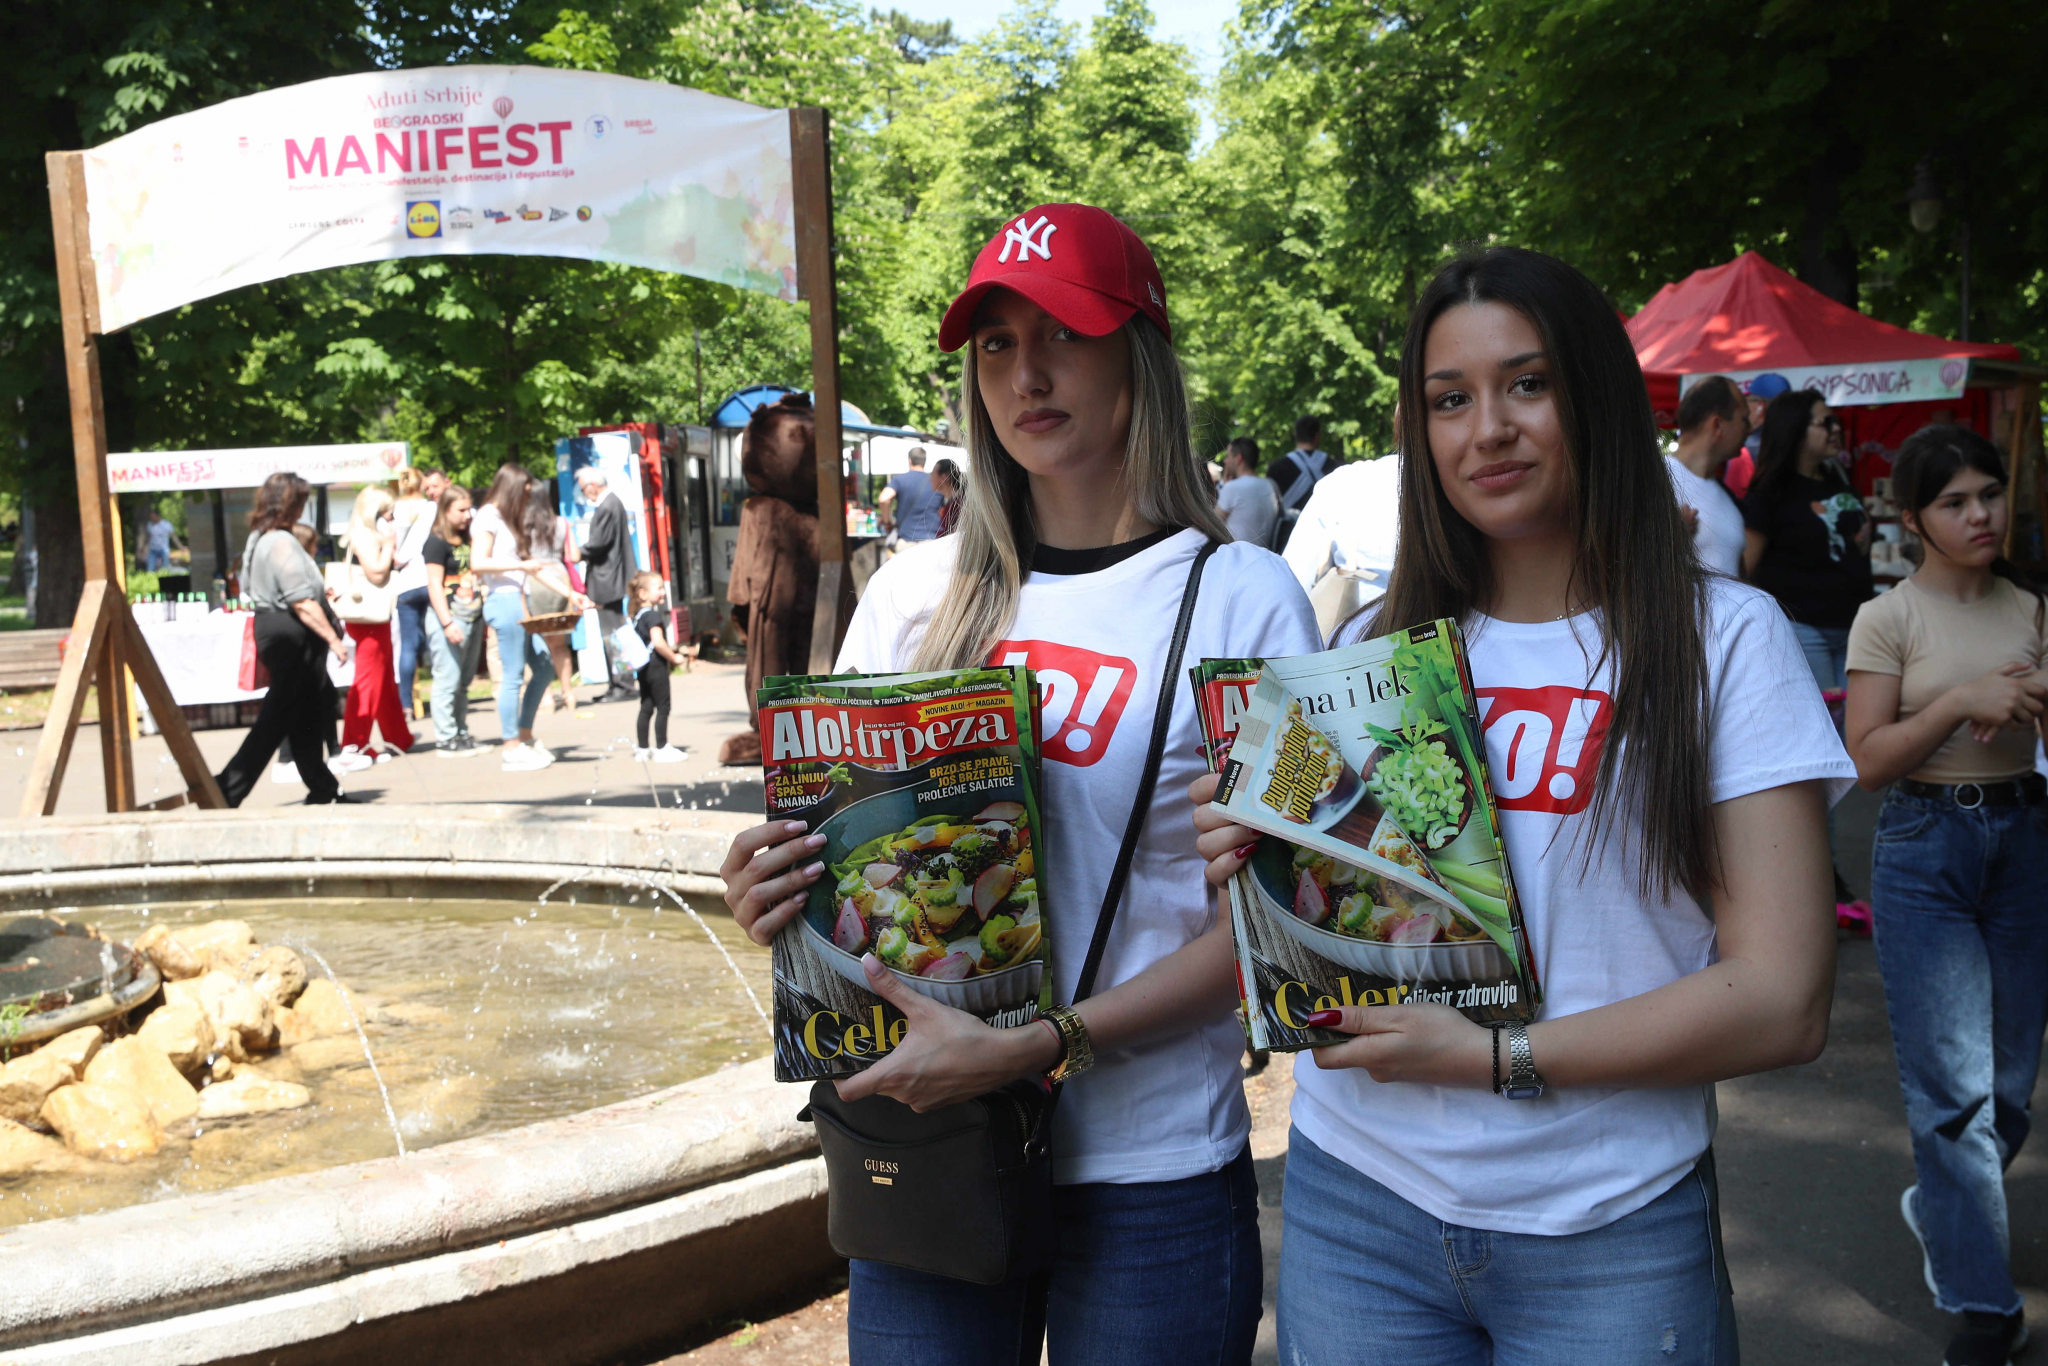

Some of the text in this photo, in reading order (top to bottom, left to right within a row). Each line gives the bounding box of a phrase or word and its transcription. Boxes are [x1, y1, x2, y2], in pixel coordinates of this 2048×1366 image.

[365, 86, 483, 111] Aduti Srbije
[373, 113, 464, 129] BEOGRADSKI
[285, 121, 572, 180] MANIFEST
[451, 171, 507, 183] destinacija
[515, 168, 575, 180] degustacija
[998, 215, 1057, 263] NY
[1802, 370, 1913, 397] GYPSONICA
[111, 458, 214, 484] MANIFEST
[1423, 629, 1437, 639] broja
[768, 697, 800, 707] PROVERENI
[800, 696, 820, 704] RECEPTI
[841, 697, 848, 705] ZA
[848, 697, 873, 706] POČETNIKE
[881, 696, 903, 706] TRIKOVI
[911, 688, 953, 701] ZANIMLJIVOSTI
[960, 682, 1003, 693] GASTRONOMIJE
[1345, 676, 1358, 709] i
[1364, 665, 1414, 704] lek
[925, 704, 949, 716] NOVINE
[950, 702, 965, 711] ALO!
[975, 697, 1006, 707] MAGAZIN
[772, 709, 1010, 772] Alo! trpeza
[929, 755, 1013, 778] BRZO SE PRAVE,
[1229, 763, 1240, 780] korak
[1261, 716, 1311, 812] Punjeni plavi
[775, 772, 824, 787] ZA LINIJU
[938, 765, 1014, 787] JOŠ BRŽE JEDU
[969, 776, 1015, 792] SALATICE
[776, 784, 804, 797] SPAS
[777, 794, 819, 809] ANANAS
[1455, 979, 1518, 1009] zdravlja
[864, 1158, 899, 1174] GUESS
